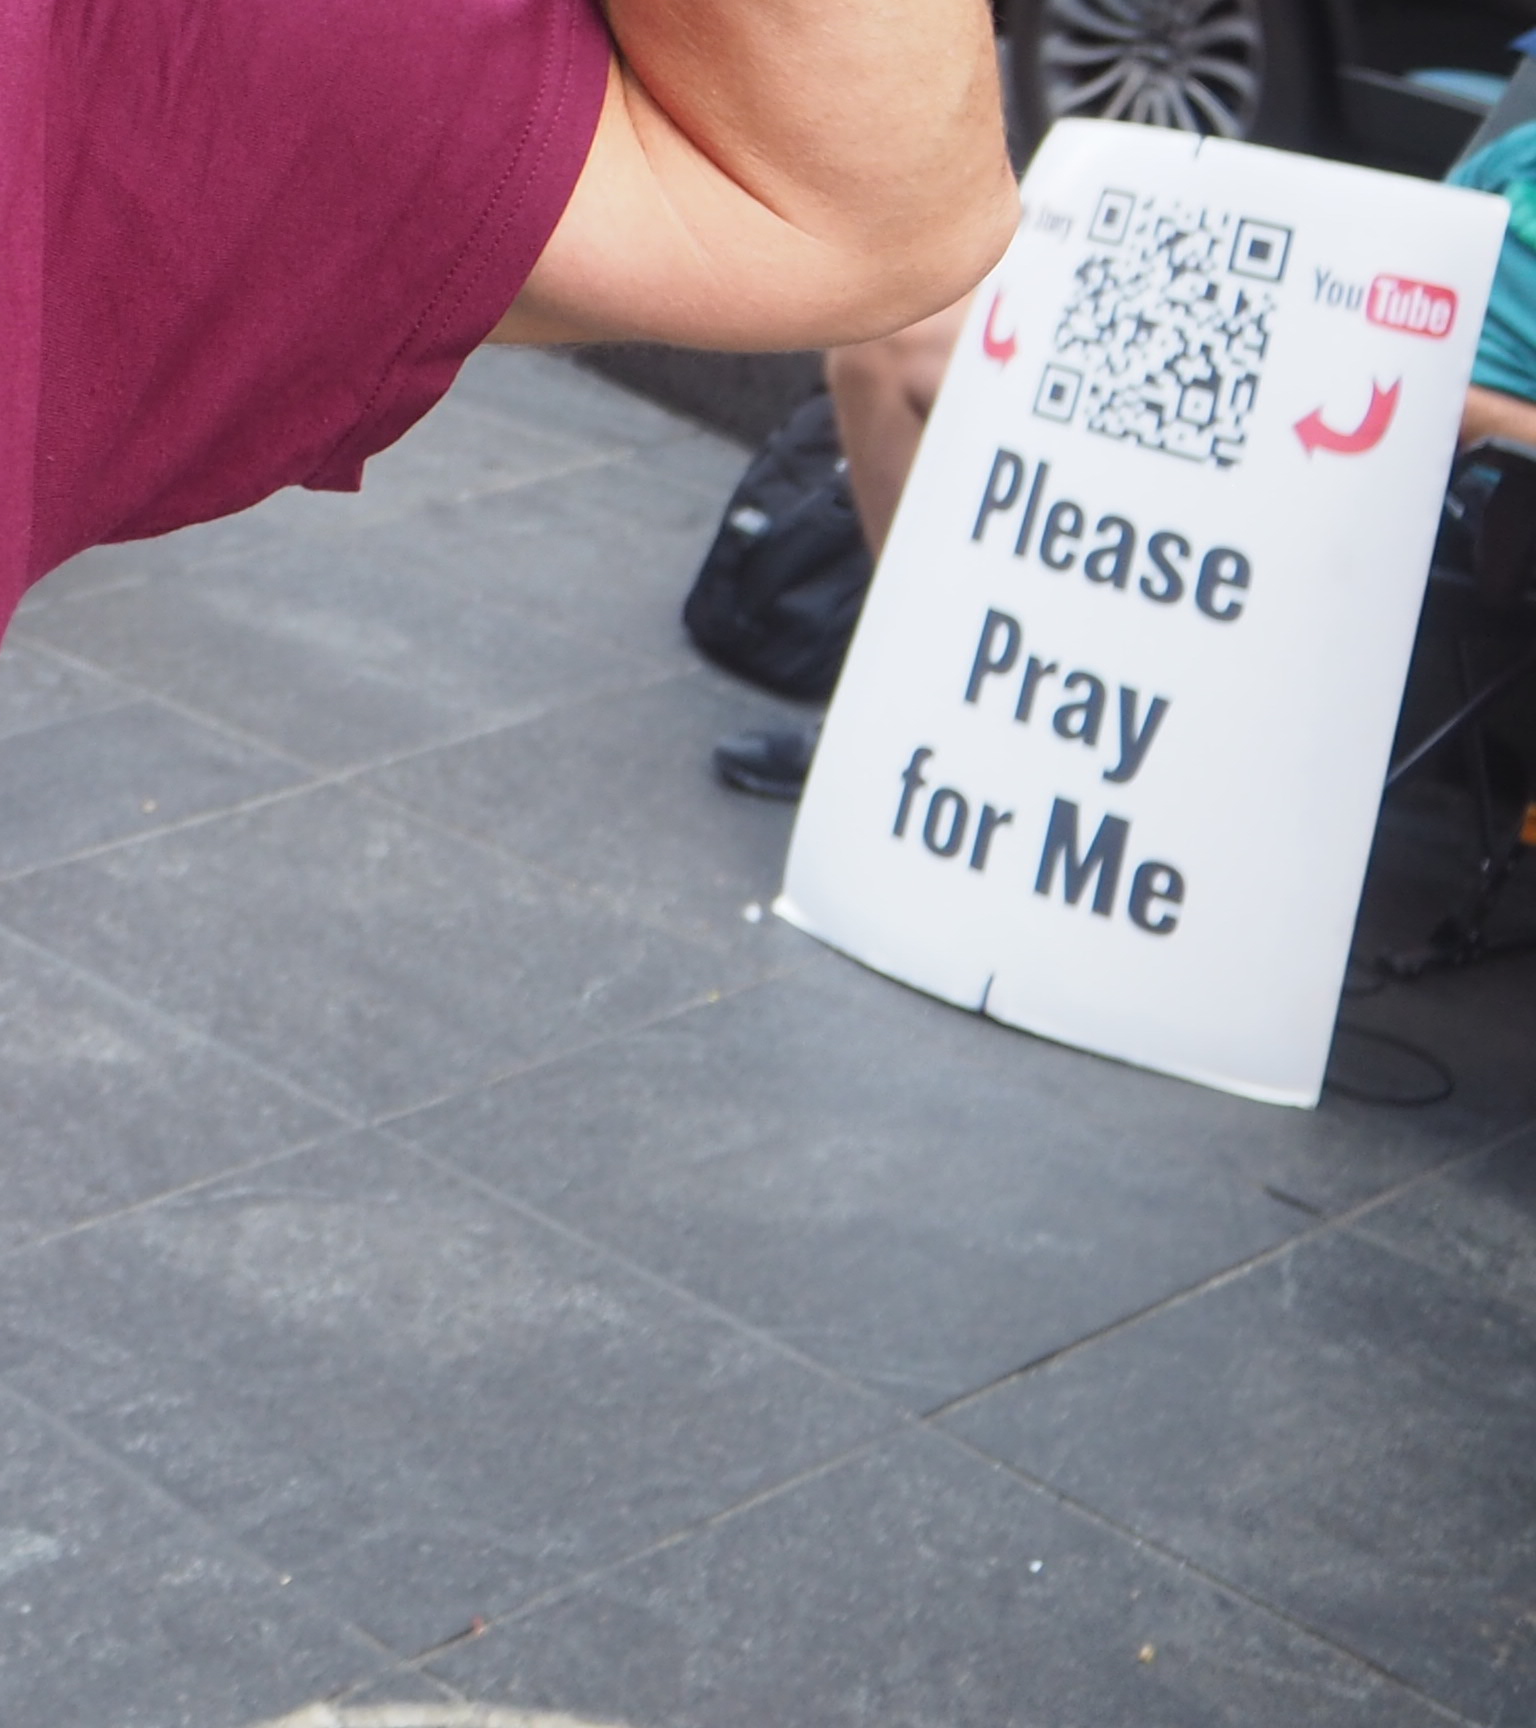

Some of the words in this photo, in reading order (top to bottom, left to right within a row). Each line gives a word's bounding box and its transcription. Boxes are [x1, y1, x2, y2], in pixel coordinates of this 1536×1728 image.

[970, 445, 1253, 624] Please
[962, 607, 1171, 785] Pray
[890, 745, 1013, 876] for
[1031, 794, 1187, 939] Me
